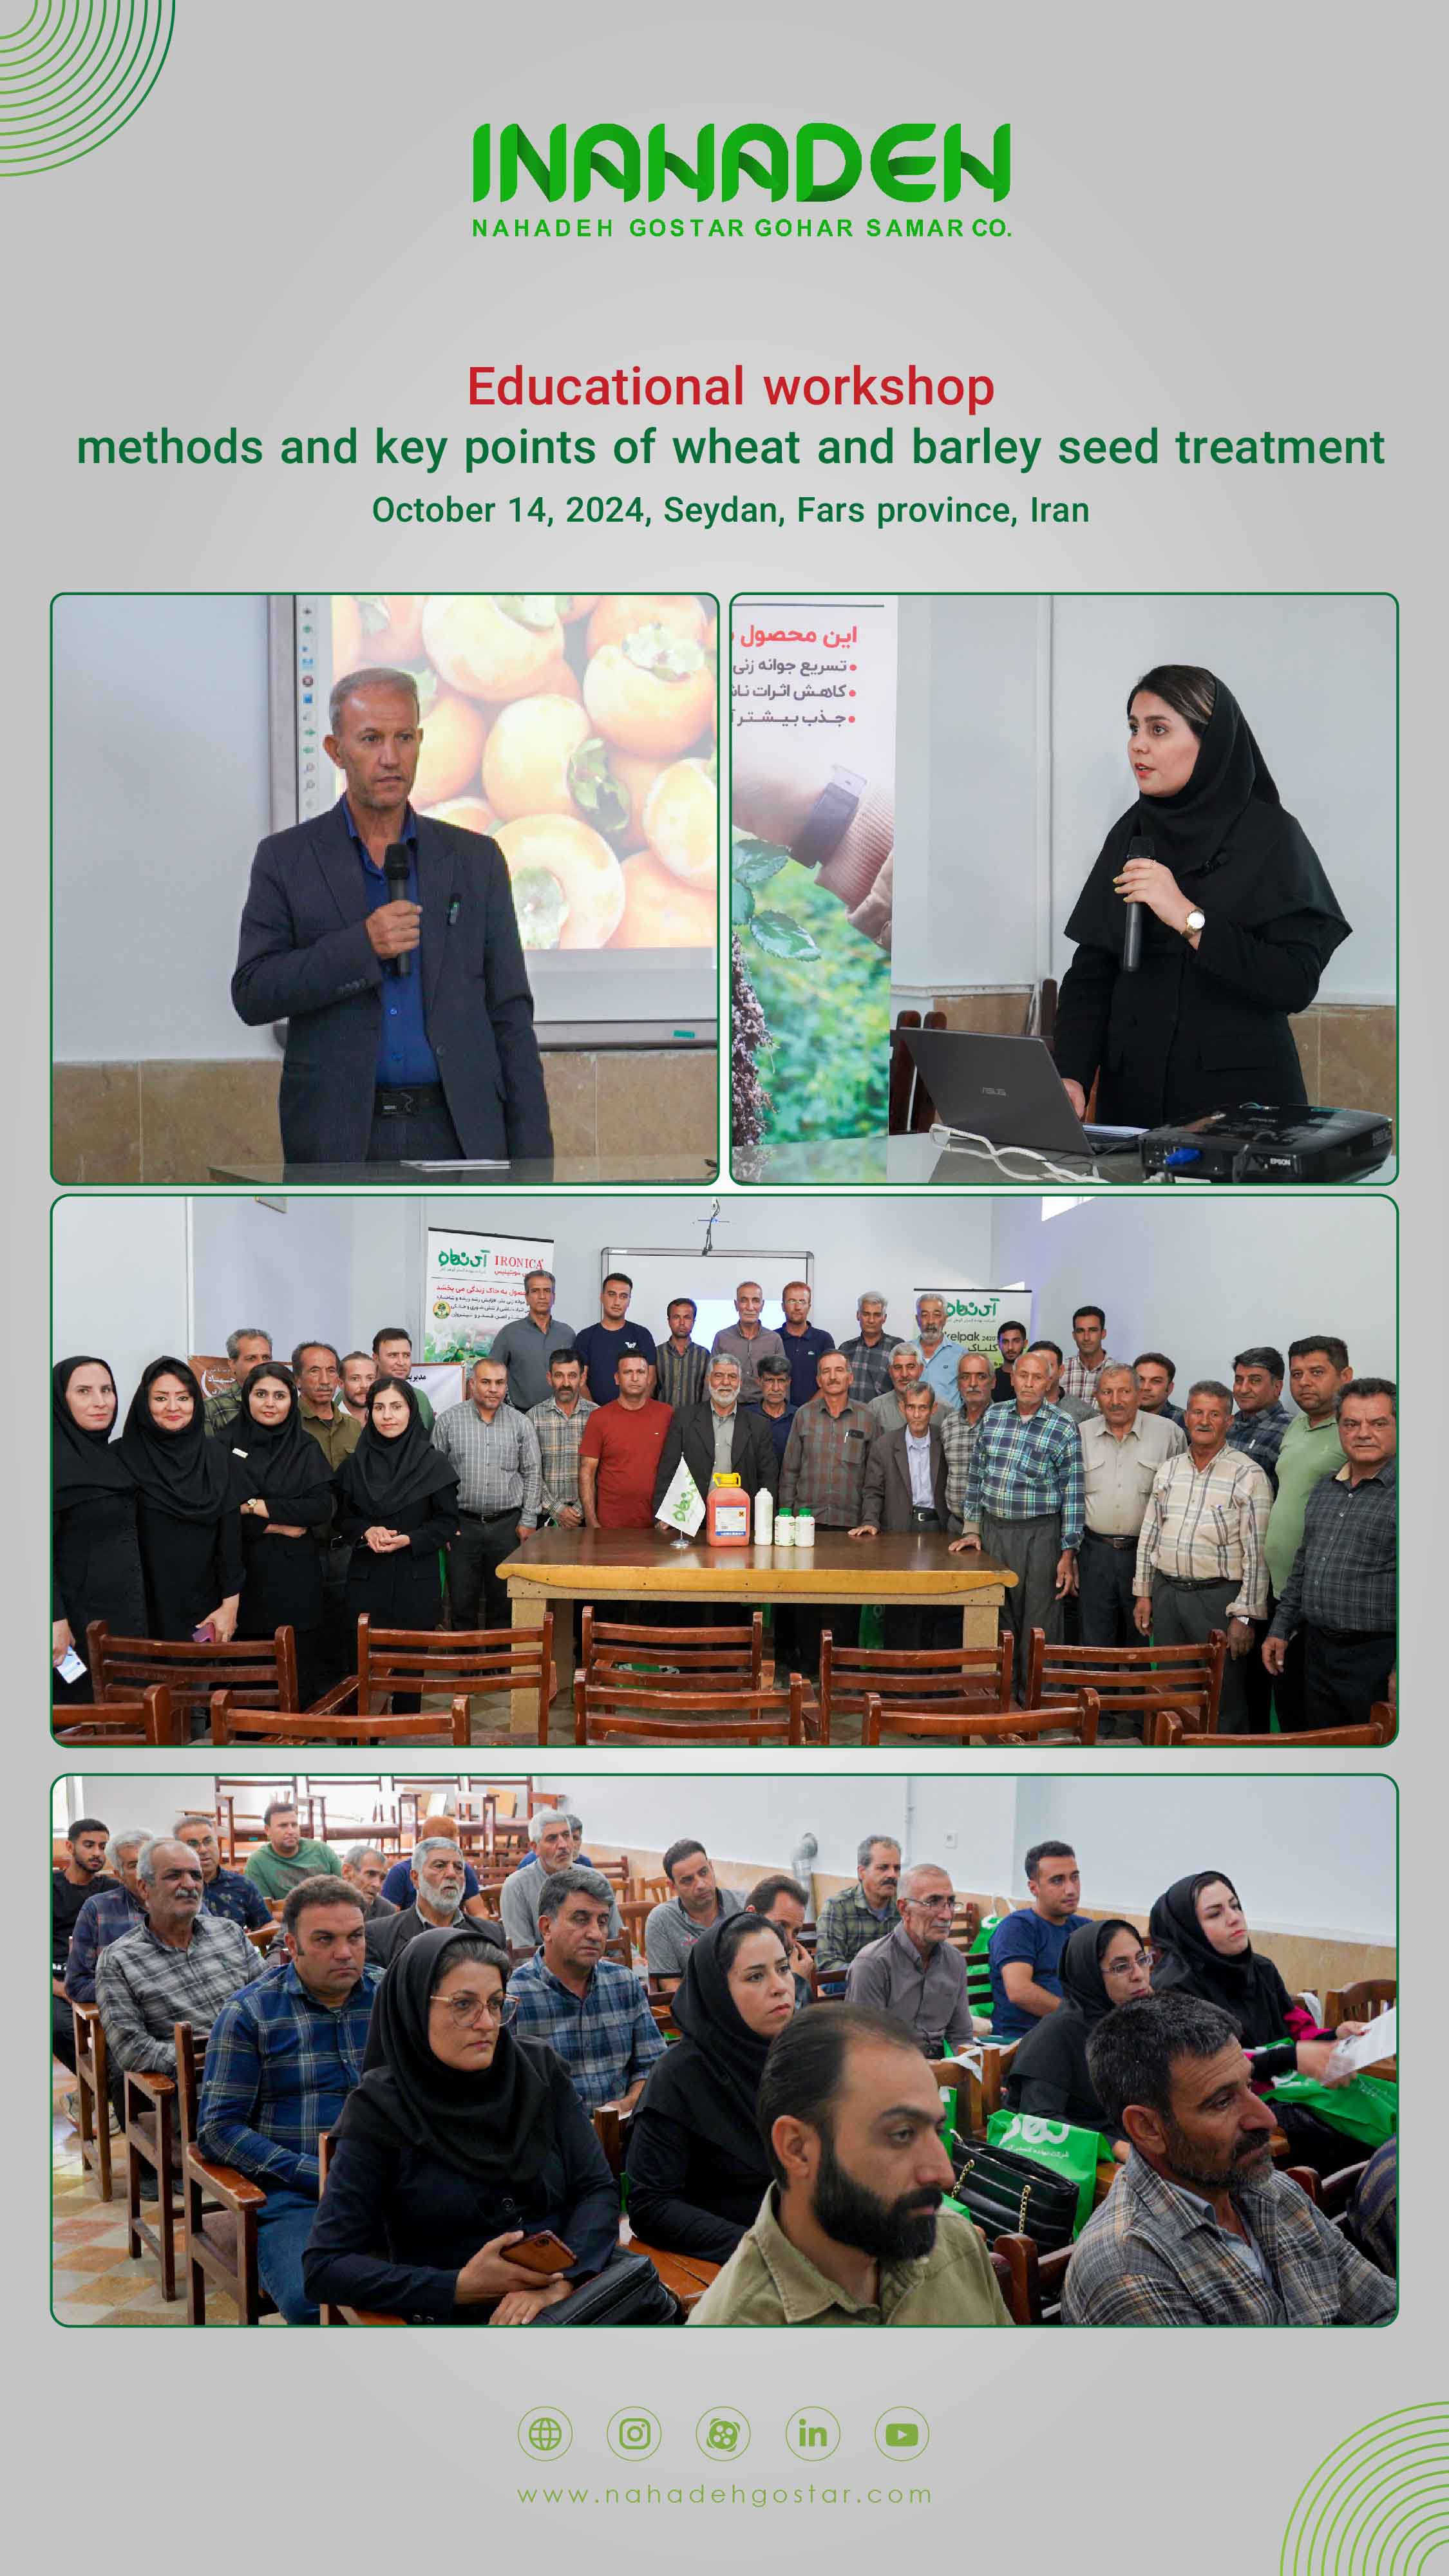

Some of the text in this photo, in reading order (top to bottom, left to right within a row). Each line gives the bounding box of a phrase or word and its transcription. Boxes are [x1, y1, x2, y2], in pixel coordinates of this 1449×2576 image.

[741, 625, 857, 648] این محصول
[733, 659, 847, 676] تسریع جوانه زنی
[752, 684, 790, 700] اثرات
[793, 685, 847, 701] کاهش
[737, 710, 799, 726] بیشتر
[802, 710, 846, 726] جذب
[495, 1256, 542, 1270] IRONICA
